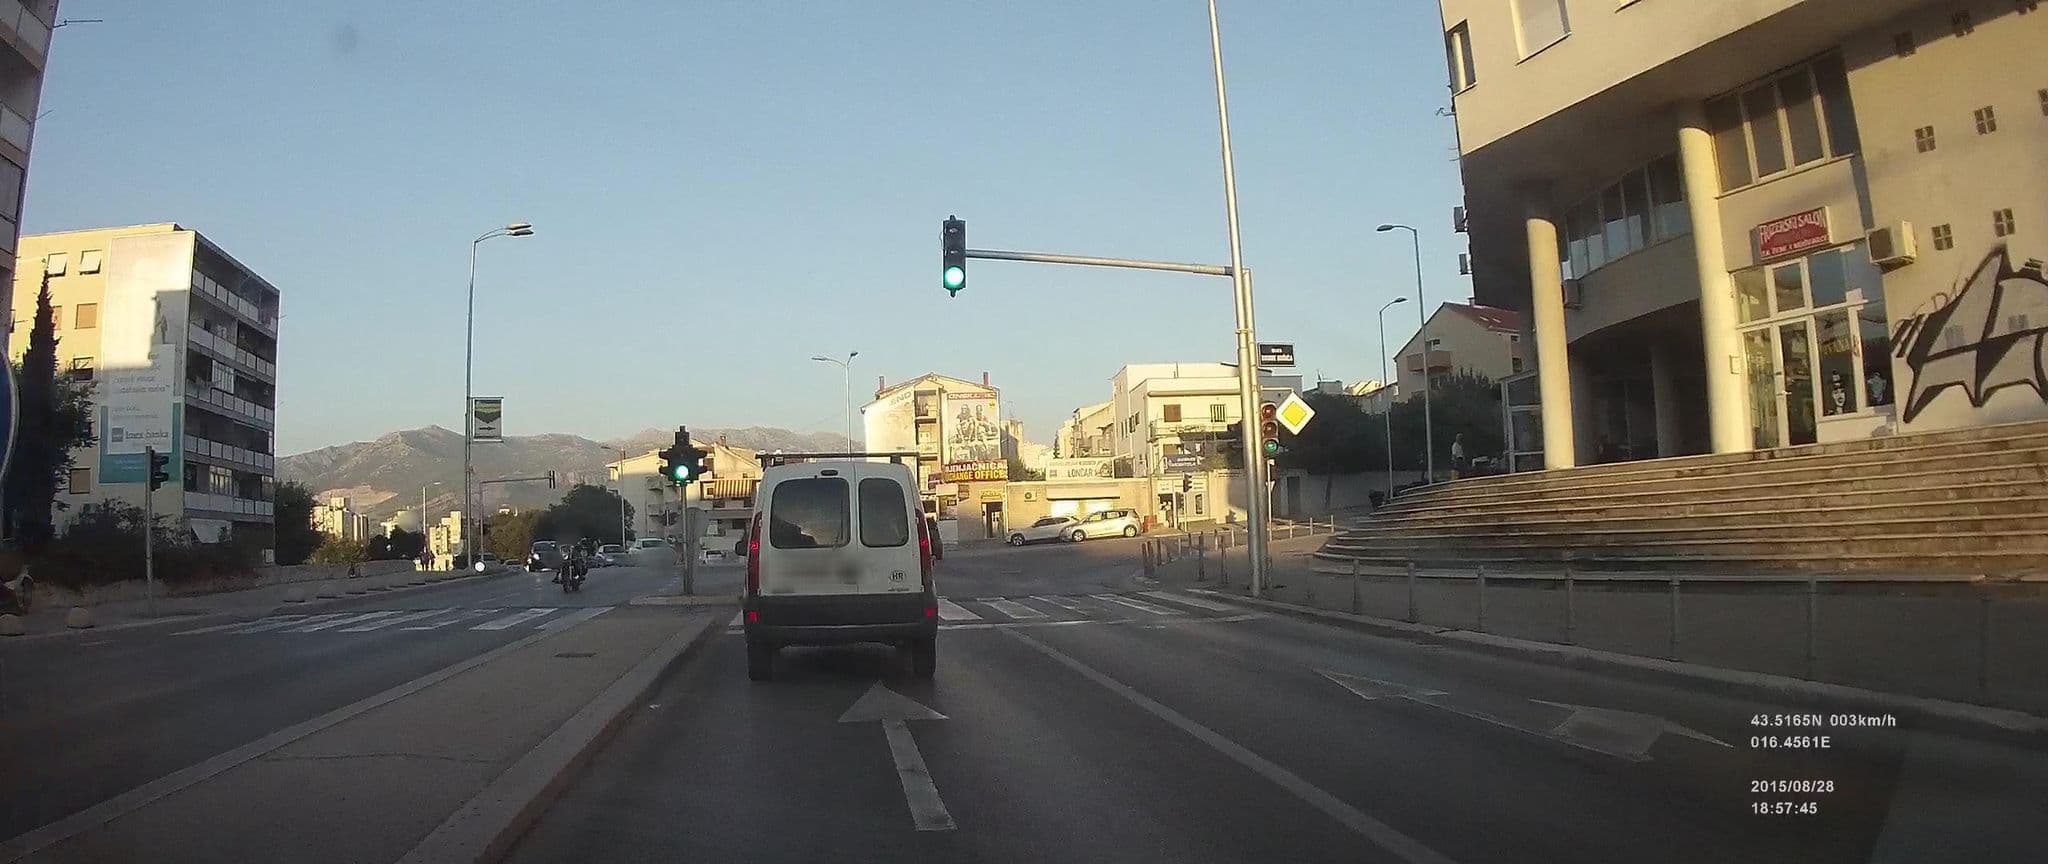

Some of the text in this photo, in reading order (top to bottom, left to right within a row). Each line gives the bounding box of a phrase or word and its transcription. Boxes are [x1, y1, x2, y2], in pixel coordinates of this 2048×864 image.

[1798, 209, 1827, 228] SALON
[975, 469, 1006, 480] OFFICE
[892, 572, 904, 580] HR
